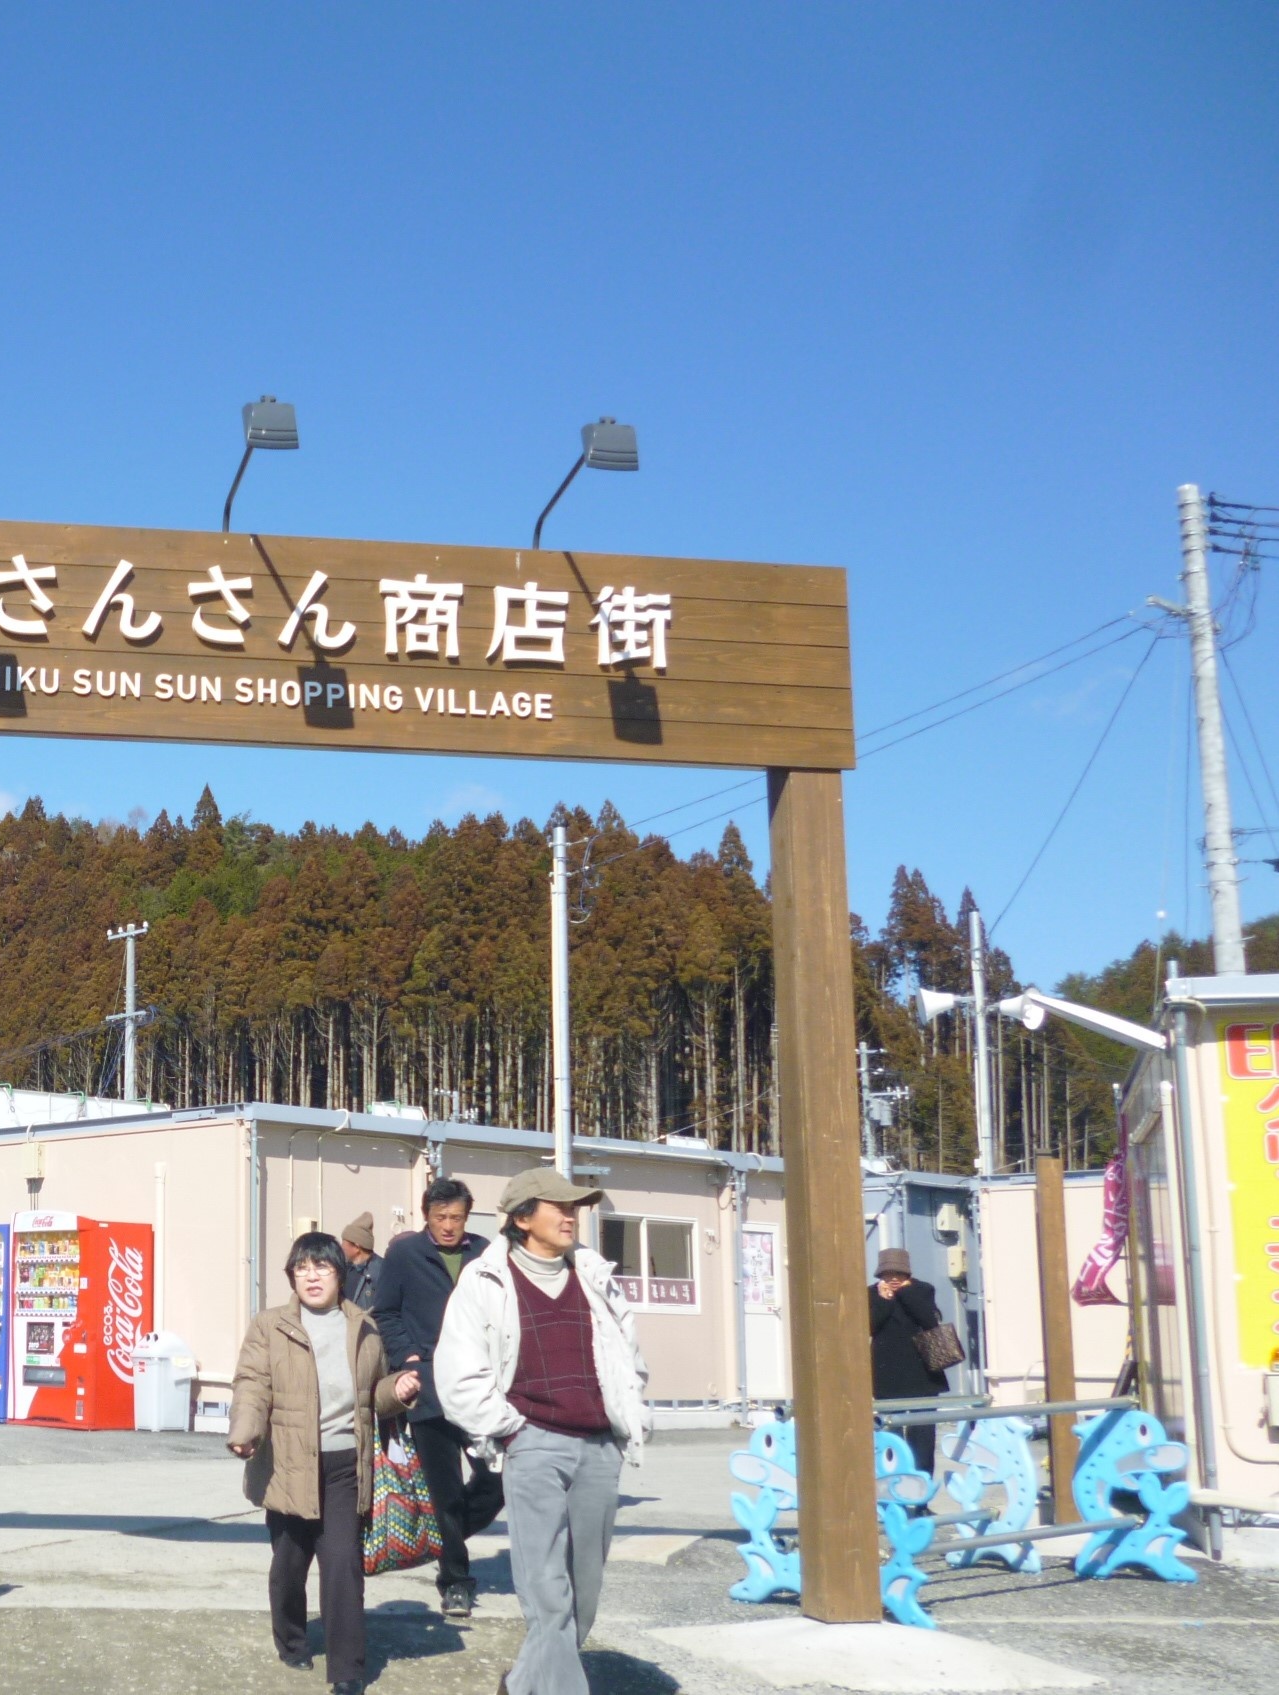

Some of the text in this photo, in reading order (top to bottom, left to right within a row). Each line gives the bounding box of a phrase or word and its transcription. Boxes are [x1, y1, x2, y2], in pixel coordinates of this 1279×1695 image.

[72, 669, 142, 699] SUN
[154, 673, 223, 703] SUN
[234, 677, 405, 713] SHOPPING
[414, 687, 554, 720] VILLAGE
